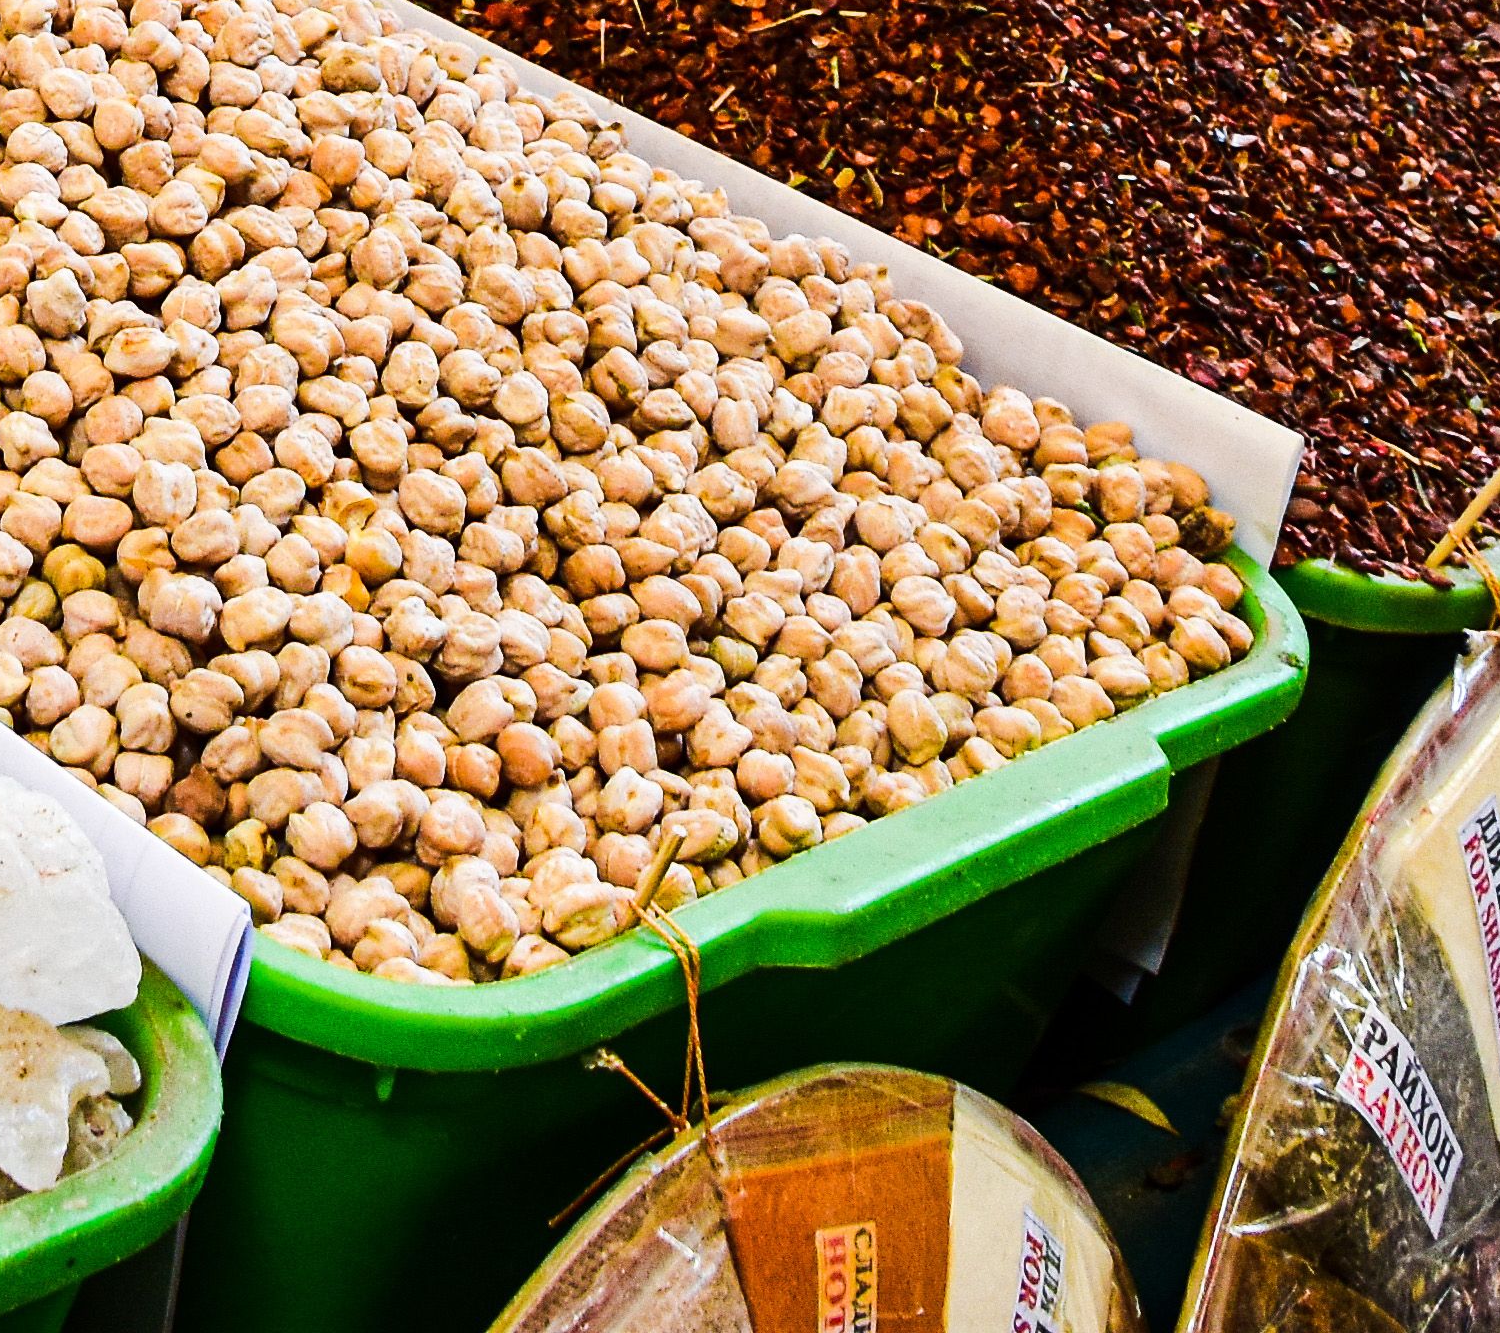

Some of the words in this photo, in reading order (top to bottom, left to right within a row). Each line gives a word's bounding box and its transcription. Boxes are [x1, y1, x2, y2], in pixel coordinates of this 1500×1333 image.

[1464, 833, 1490, 904] FOR
[1341, 1053, 1443, 1220] RAYHON
[1361, 1017, 1456, 1183] РАЙХОН
[823, 1235, 846, 1333] HOT
[1018, 1229, 1043, 1310] FOR
[1041, 1234, 1061, 1314] ДЛЯ
